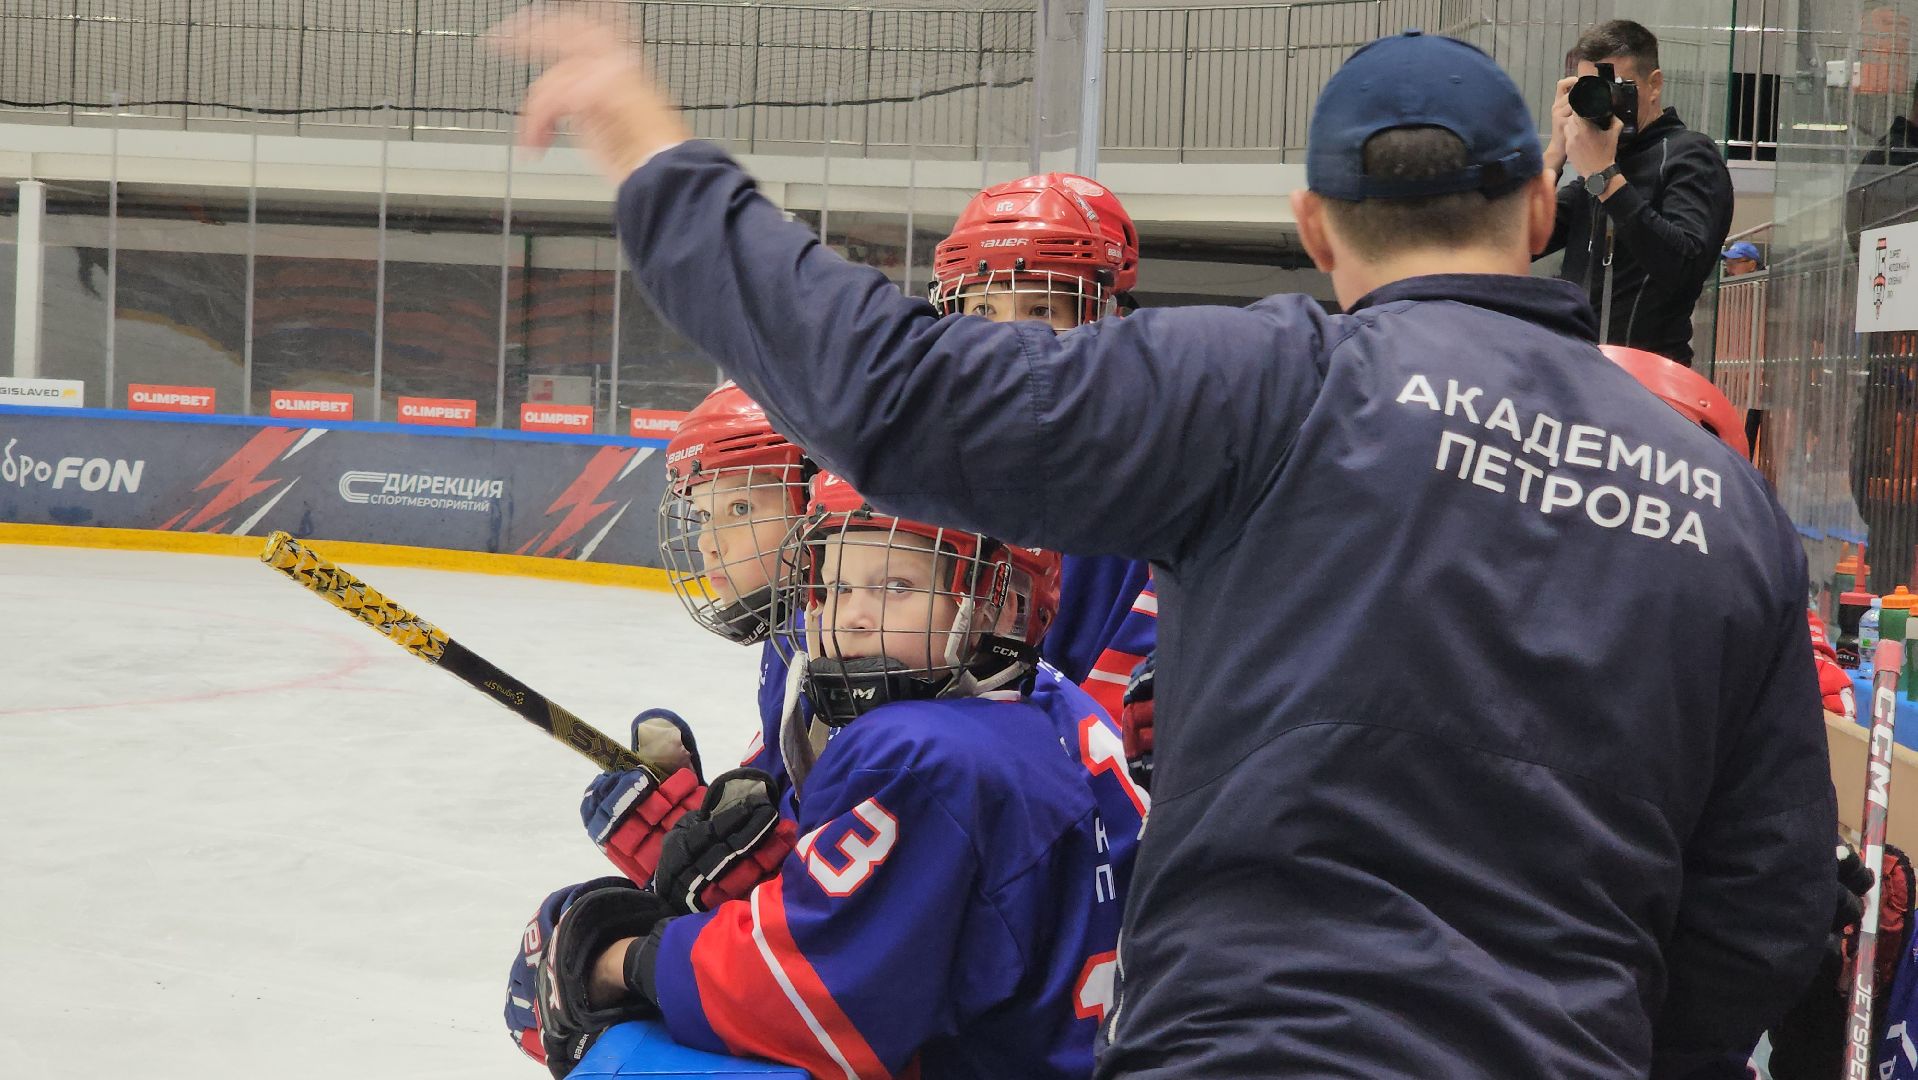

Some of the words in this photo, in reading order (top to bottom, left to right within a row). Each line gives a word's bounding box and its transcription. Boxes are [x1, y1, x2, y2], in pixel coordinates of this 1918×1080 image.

[132, 391, 210, 407] OLIMPBET
[274, 398, 349, 413] OLIMPBET
[402, 404, 472, 420] OLIMPBET
[524, 411, 590, 426] OLIMPBET
[633, 417, 679, 431] OLIMPB
[1395, 374, 1722, 508] АКАДЕМИЯ
[382, 473, 504, 500] ДИРЕКЦИЯ
[1434, 429, 1709, 555] ПЕТРОВА
[370, 494, 492, 513] СПОРТМЕРОПРИЯТИЙ
[992, 645, 1019, 659] CCM
[1867, 686, 1896, 810] CCM
[1850, 973, 1872, 1080] JETSPE
